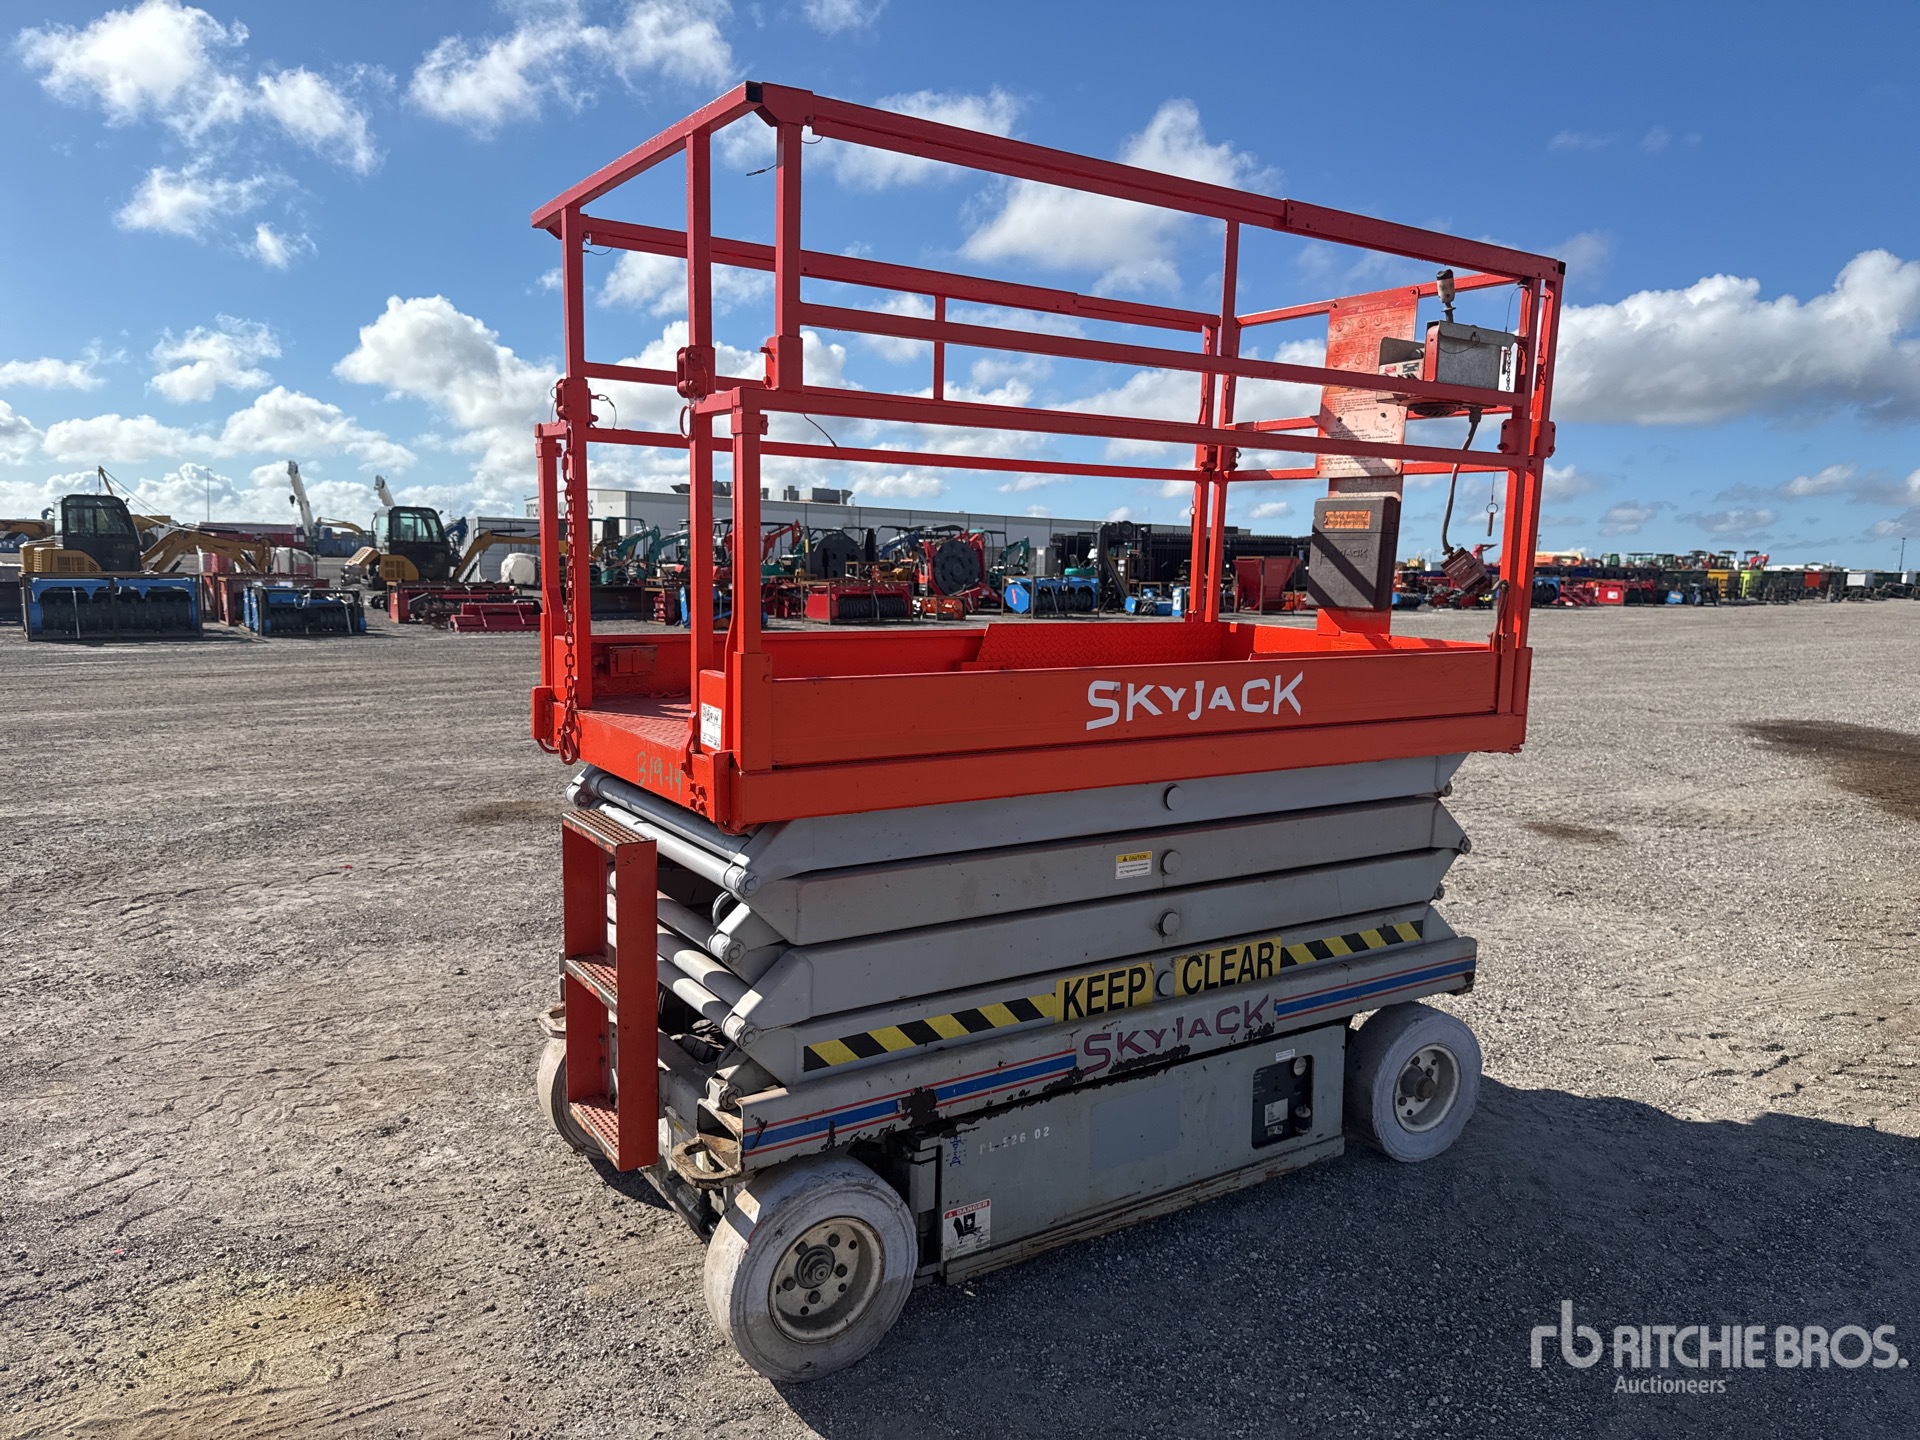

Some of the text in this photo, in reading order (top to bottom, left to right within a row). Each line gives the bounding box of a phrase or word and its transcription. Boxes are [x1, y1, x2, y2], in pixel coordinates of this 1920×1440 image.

[1086, 671, 1303, 730] SKYJACK
[1063, 941, 1276, 1021] KEEP CLEAR
[1083, 994, 1269, 1075] SKYJACK
[956, 1201, 988, 1215] DANGER
